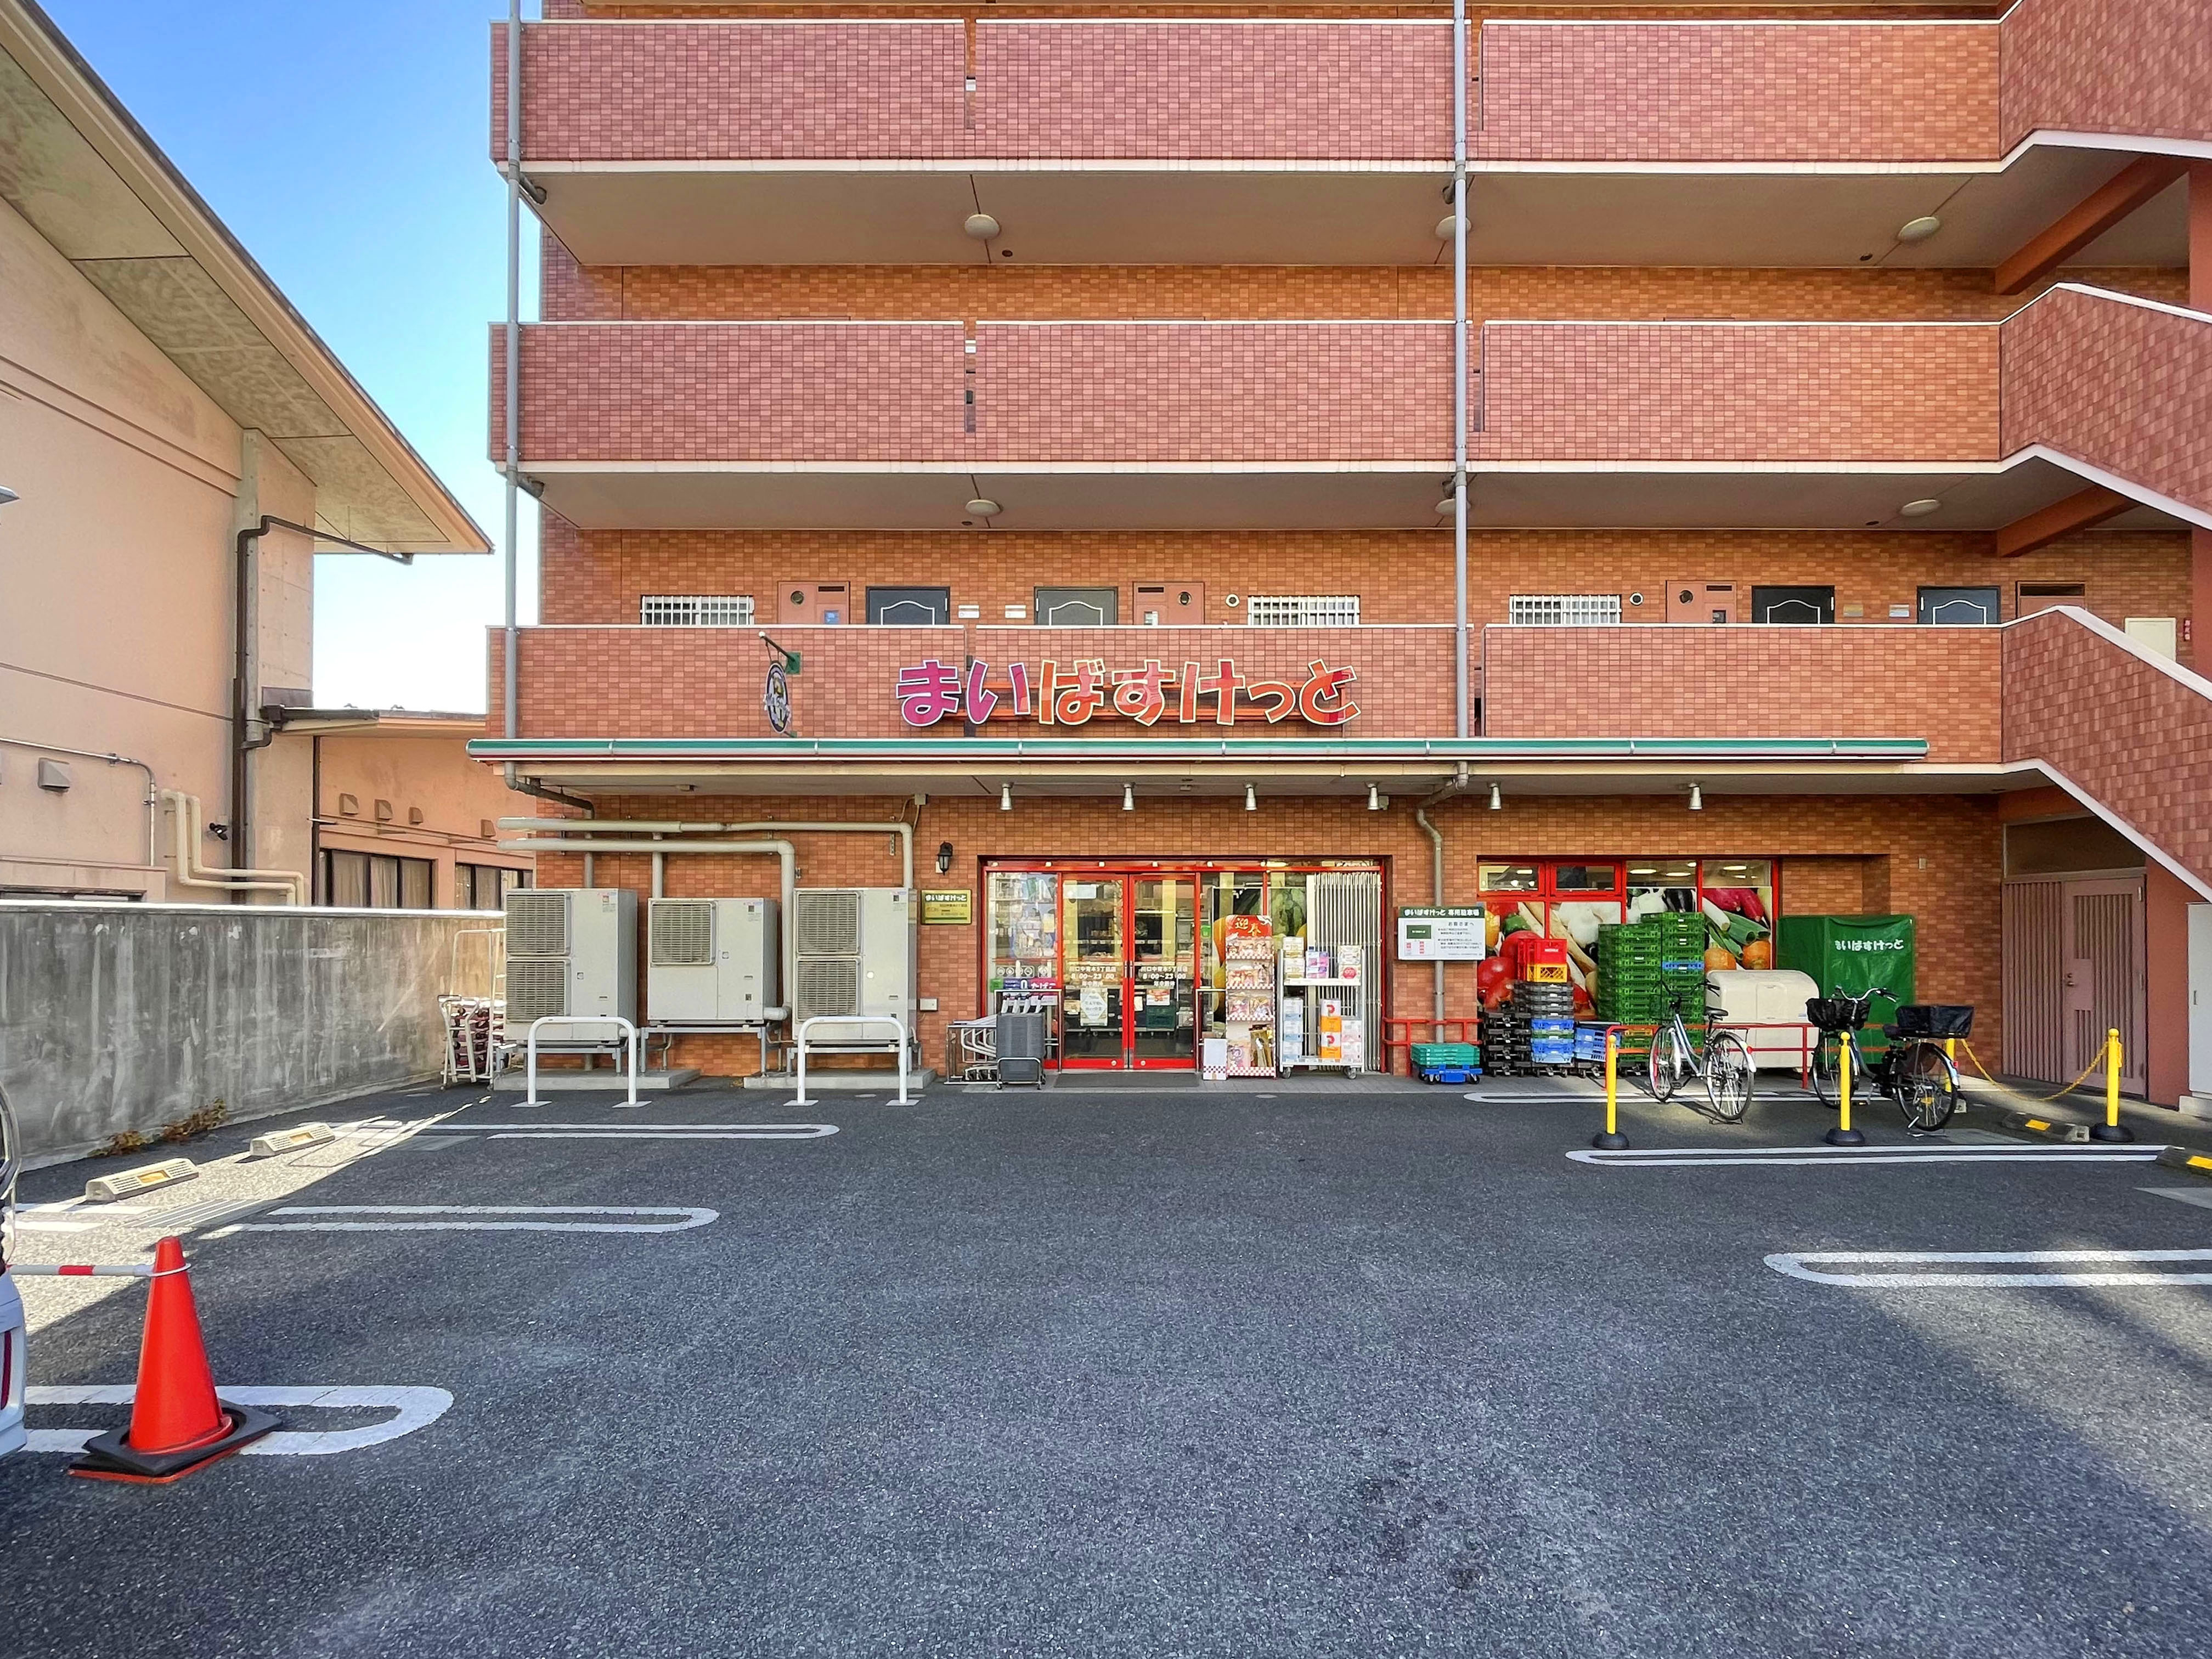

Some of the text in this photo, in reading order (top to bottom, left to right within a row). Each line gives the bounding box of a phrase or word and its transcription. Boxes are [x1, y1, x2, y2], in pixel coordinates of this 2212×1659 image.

[896, 658, 1362, 727] まいばすけっと
[1234, 917, 1262, 937] 迎春
[1834, 939, 1904, 952] まいばすけっと
